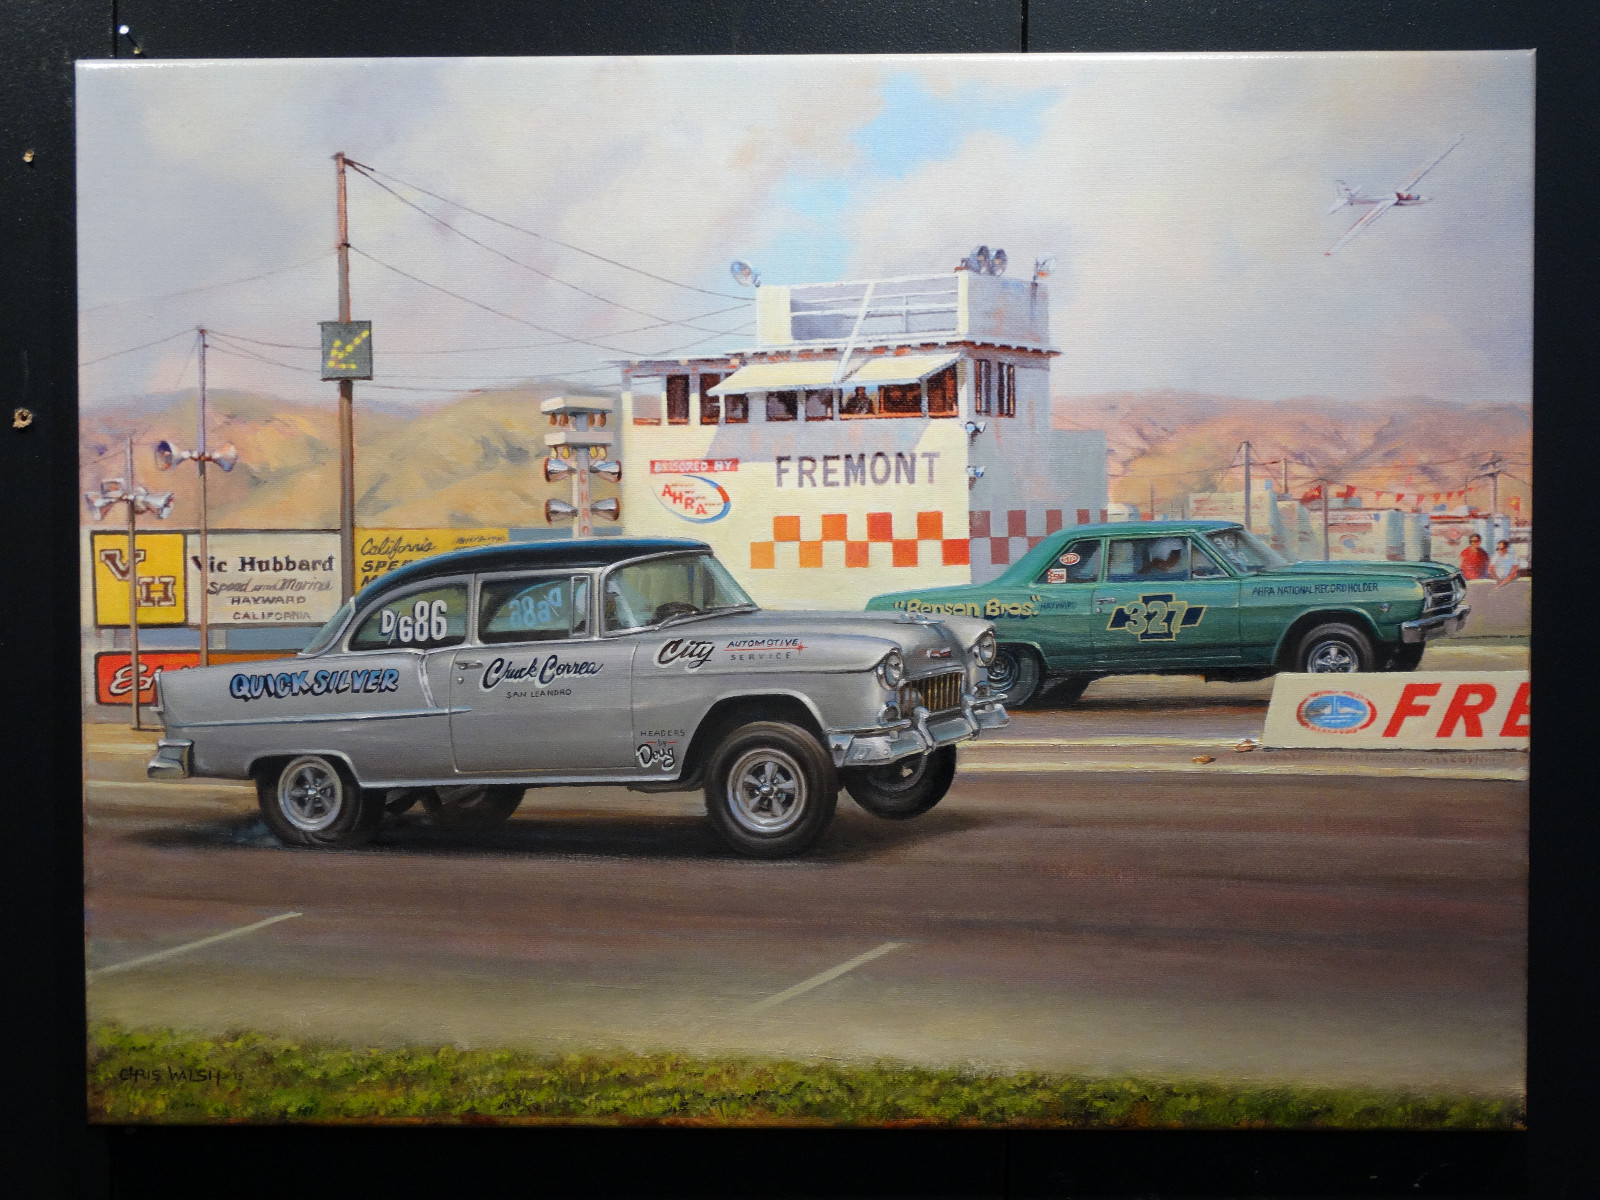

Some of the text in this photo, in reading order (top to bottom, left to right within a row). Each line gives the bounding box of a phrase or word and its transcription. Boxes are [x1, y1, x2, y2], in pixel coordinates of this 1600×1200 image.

[775, 451, 940, 488] FREMONT
[661, 484, 708, 515] AHRA
[238, 554, 335, 573] Hubbard
[138, 576, 176, 607] H
[230, 596, 306, 605] HAYWARD
[1252, 582, 1378, 595] AHRA NATIONAL RECORD HOLDER
[233, 611, 311, 620] CALIFORNIA
[1123, 600, 1188, 634] 327
[654, 638, 716, 671] City
[727, 638, 800, 648] AUTOMOTIVE
[730, 651, 792, 661] SERVICE
[480, 654, 604, 691] Chuck Correa
[507, 688, 572, 699] SAN LEANDRO
[1382, 682, 1531, 738] FRE
[636, 743, 676, 771] Doug
[168, 1066, 221, 1086] WALSH
